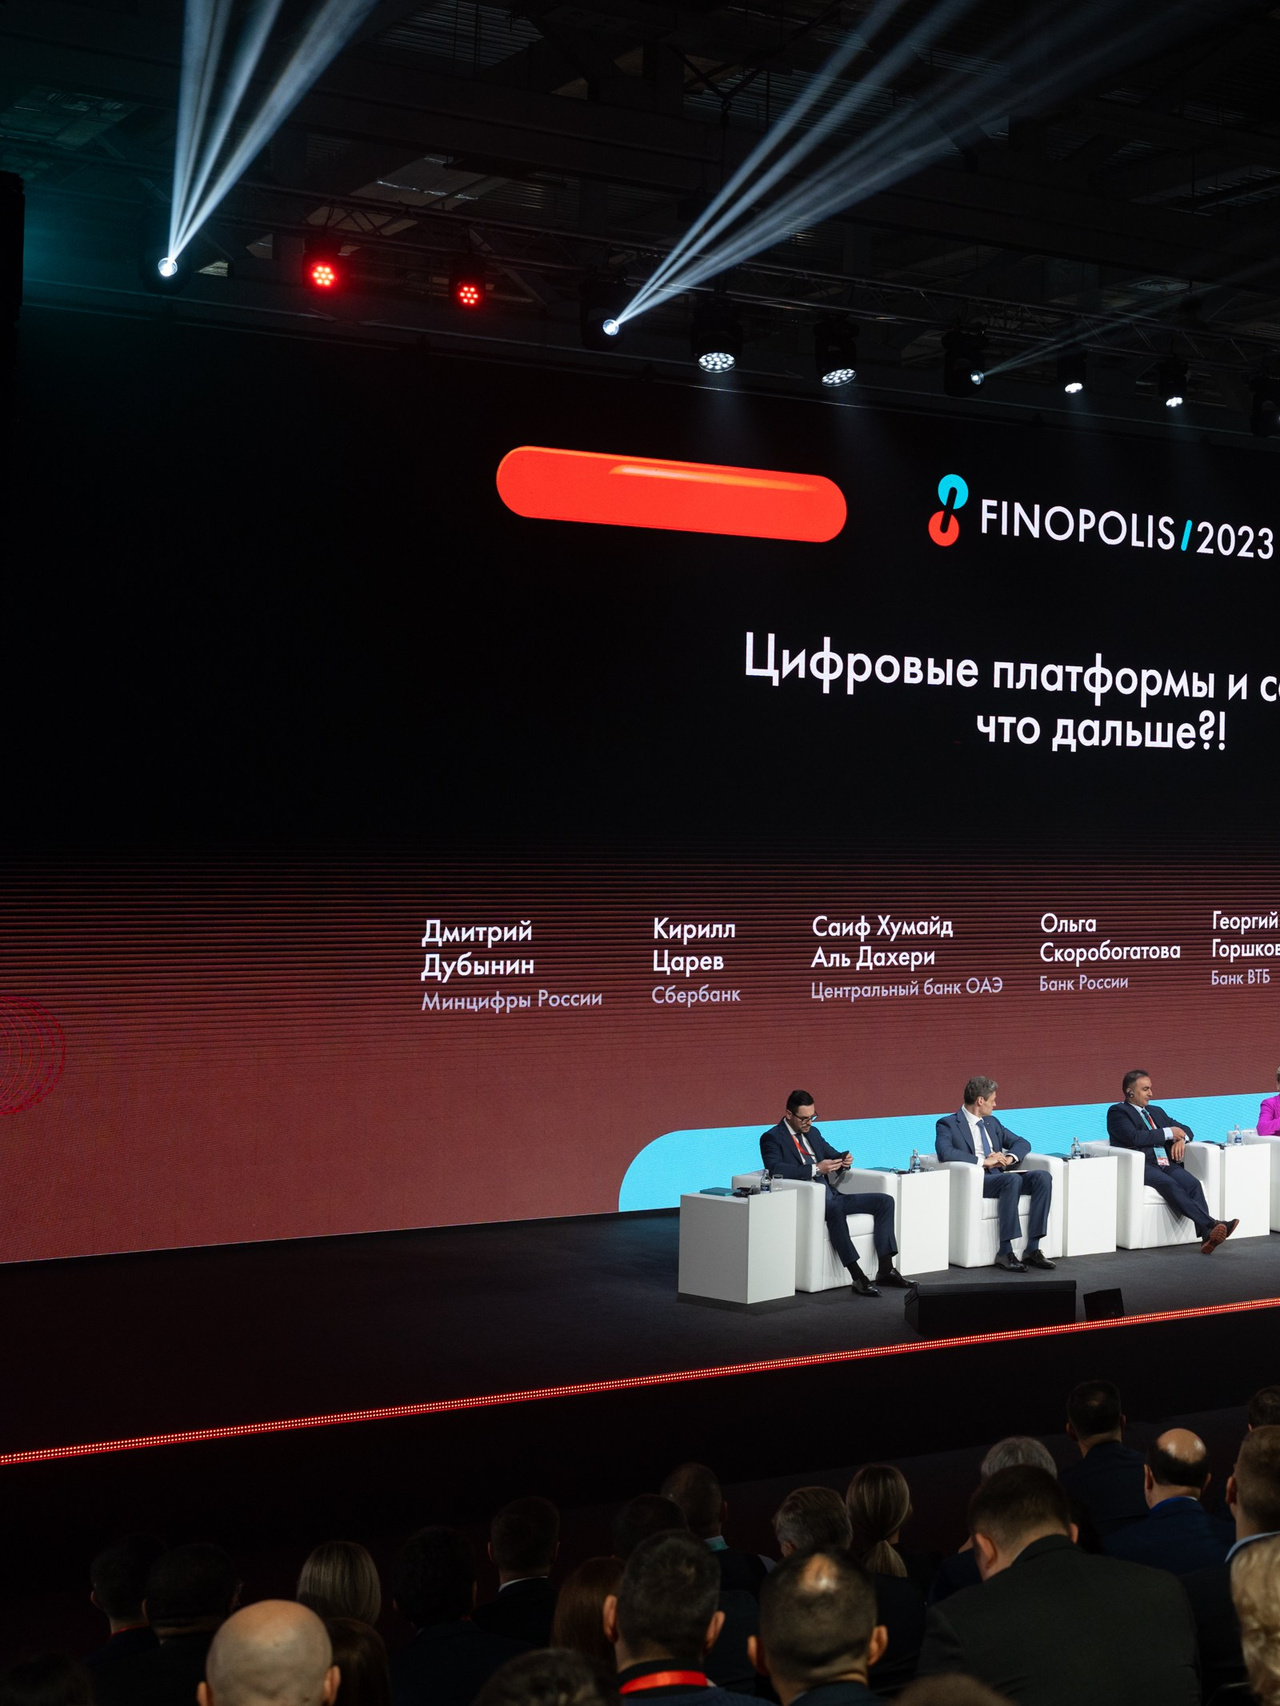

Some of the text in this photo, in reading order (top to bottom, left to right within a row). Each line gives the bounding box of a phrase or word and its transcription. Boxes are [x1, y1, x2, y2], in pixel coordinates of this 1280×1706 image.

[745, 631, 979, 695] Цифровые
[993, 652, 1215, 708] платформы
[1228, 673, 1248, 701] и
[976, 709, 1226, 753] что дальше?!
[421, 919, 532, 948] Дмитрий
[653, 917, 736, 946] Кирилл
[812, 914, 954, 942] Саиф Хумайд
[1040, 912, 1097, 933] Ольга
[1212, 910, 1279, 935] Георгий
[653, 949, 724, 976] Царев
[810, 945, 935, 972] Аль Дахери
[1040, 940, 1181, 967] Скоробогатова
[420, 952, 534, 983] Дубынин
[1211, 968, 1271, 986] Банк ВТБ
[651, 985, 741, 1007] Сбербанк
[811, 976, 1003, 1003] Центральный банк ОАЭ
[1039, 974, 1129, 992] Банк России
[421, 989, 603, 1014] Минцифры России
